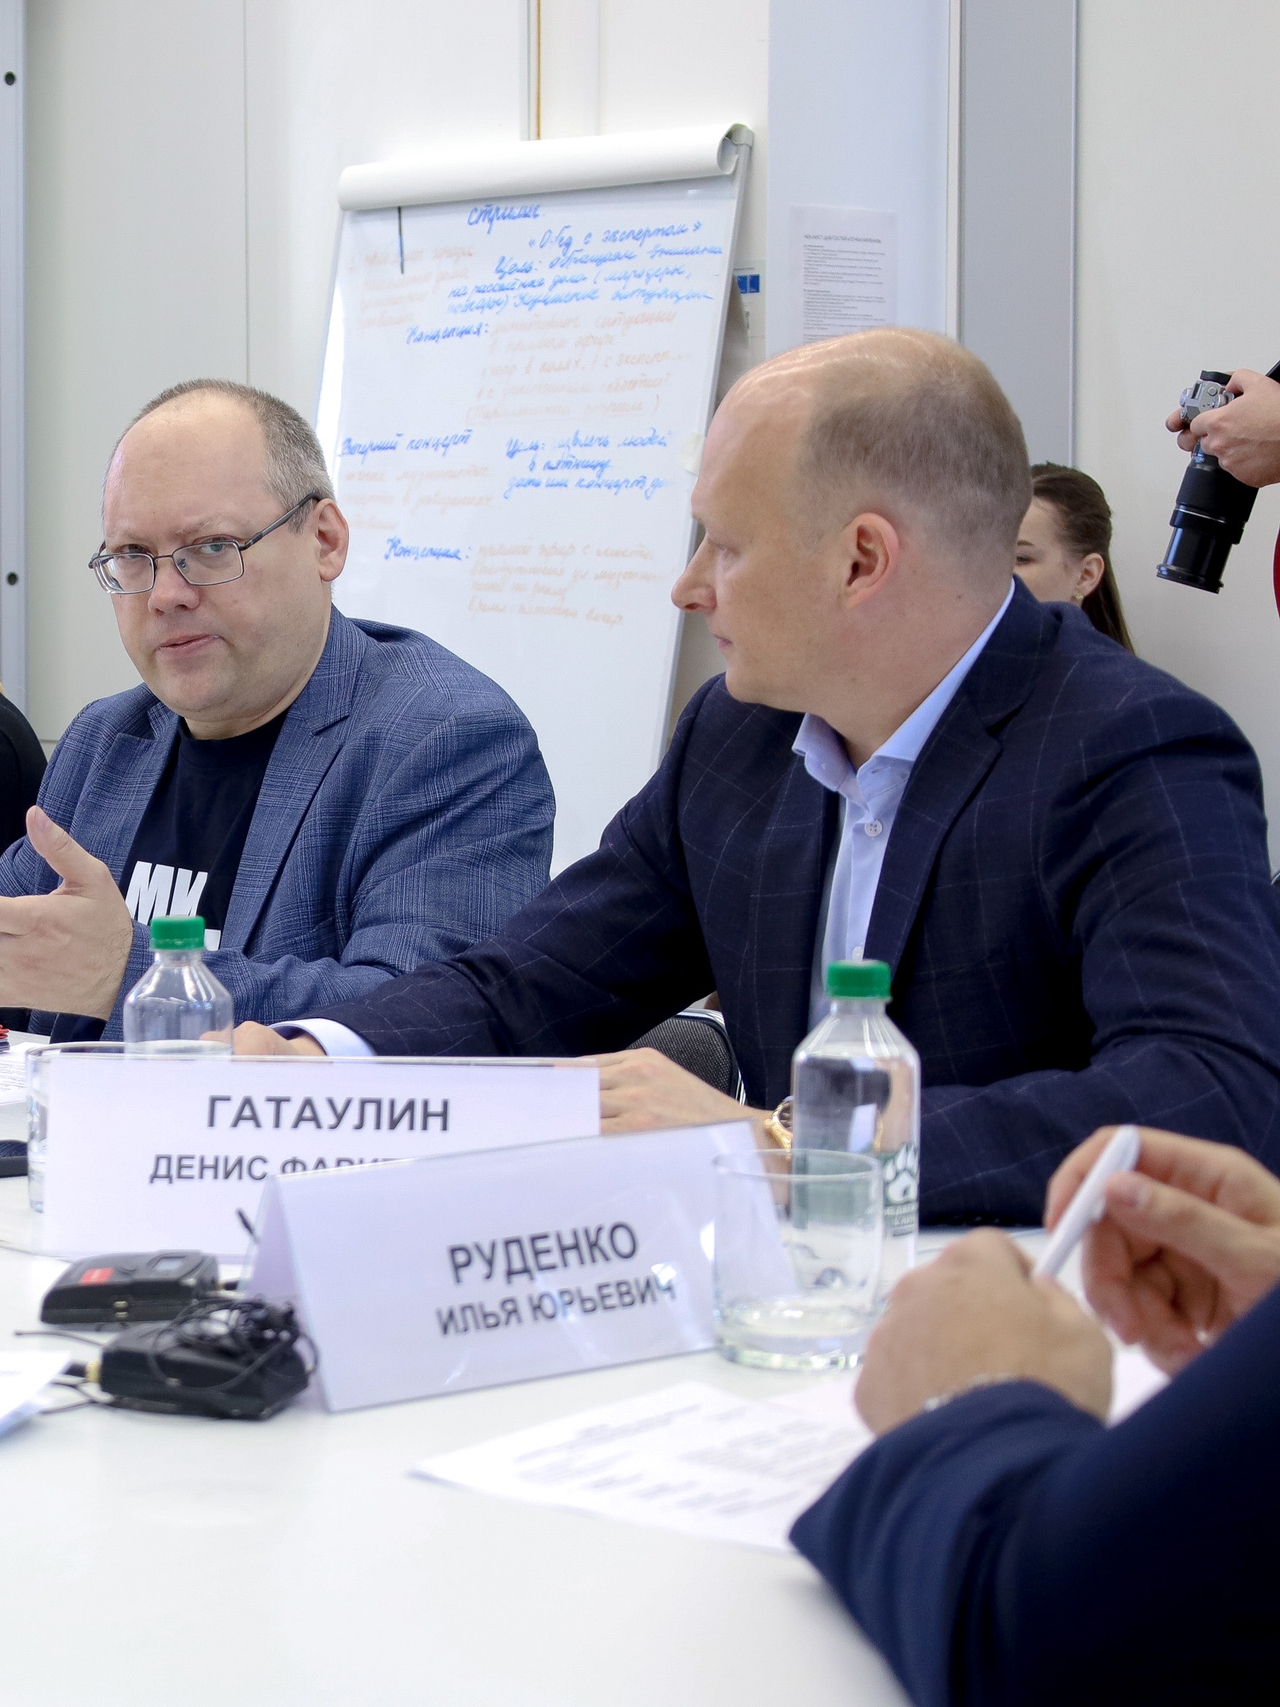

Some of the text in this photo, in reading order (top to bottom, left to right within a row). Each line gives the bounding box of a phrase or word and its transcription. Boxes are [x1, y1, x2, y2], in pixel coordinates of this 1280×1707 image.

[206, 1094, 451, 1132] ГАТАУЛИН
[149, 1153, 269, 1184] ДЕНИС
[448, 1220, 638, 1285] РУДЕНКО
[435, 1274, 677, 1337] ИЛЬЯ ЮРЬЕВИЧ
